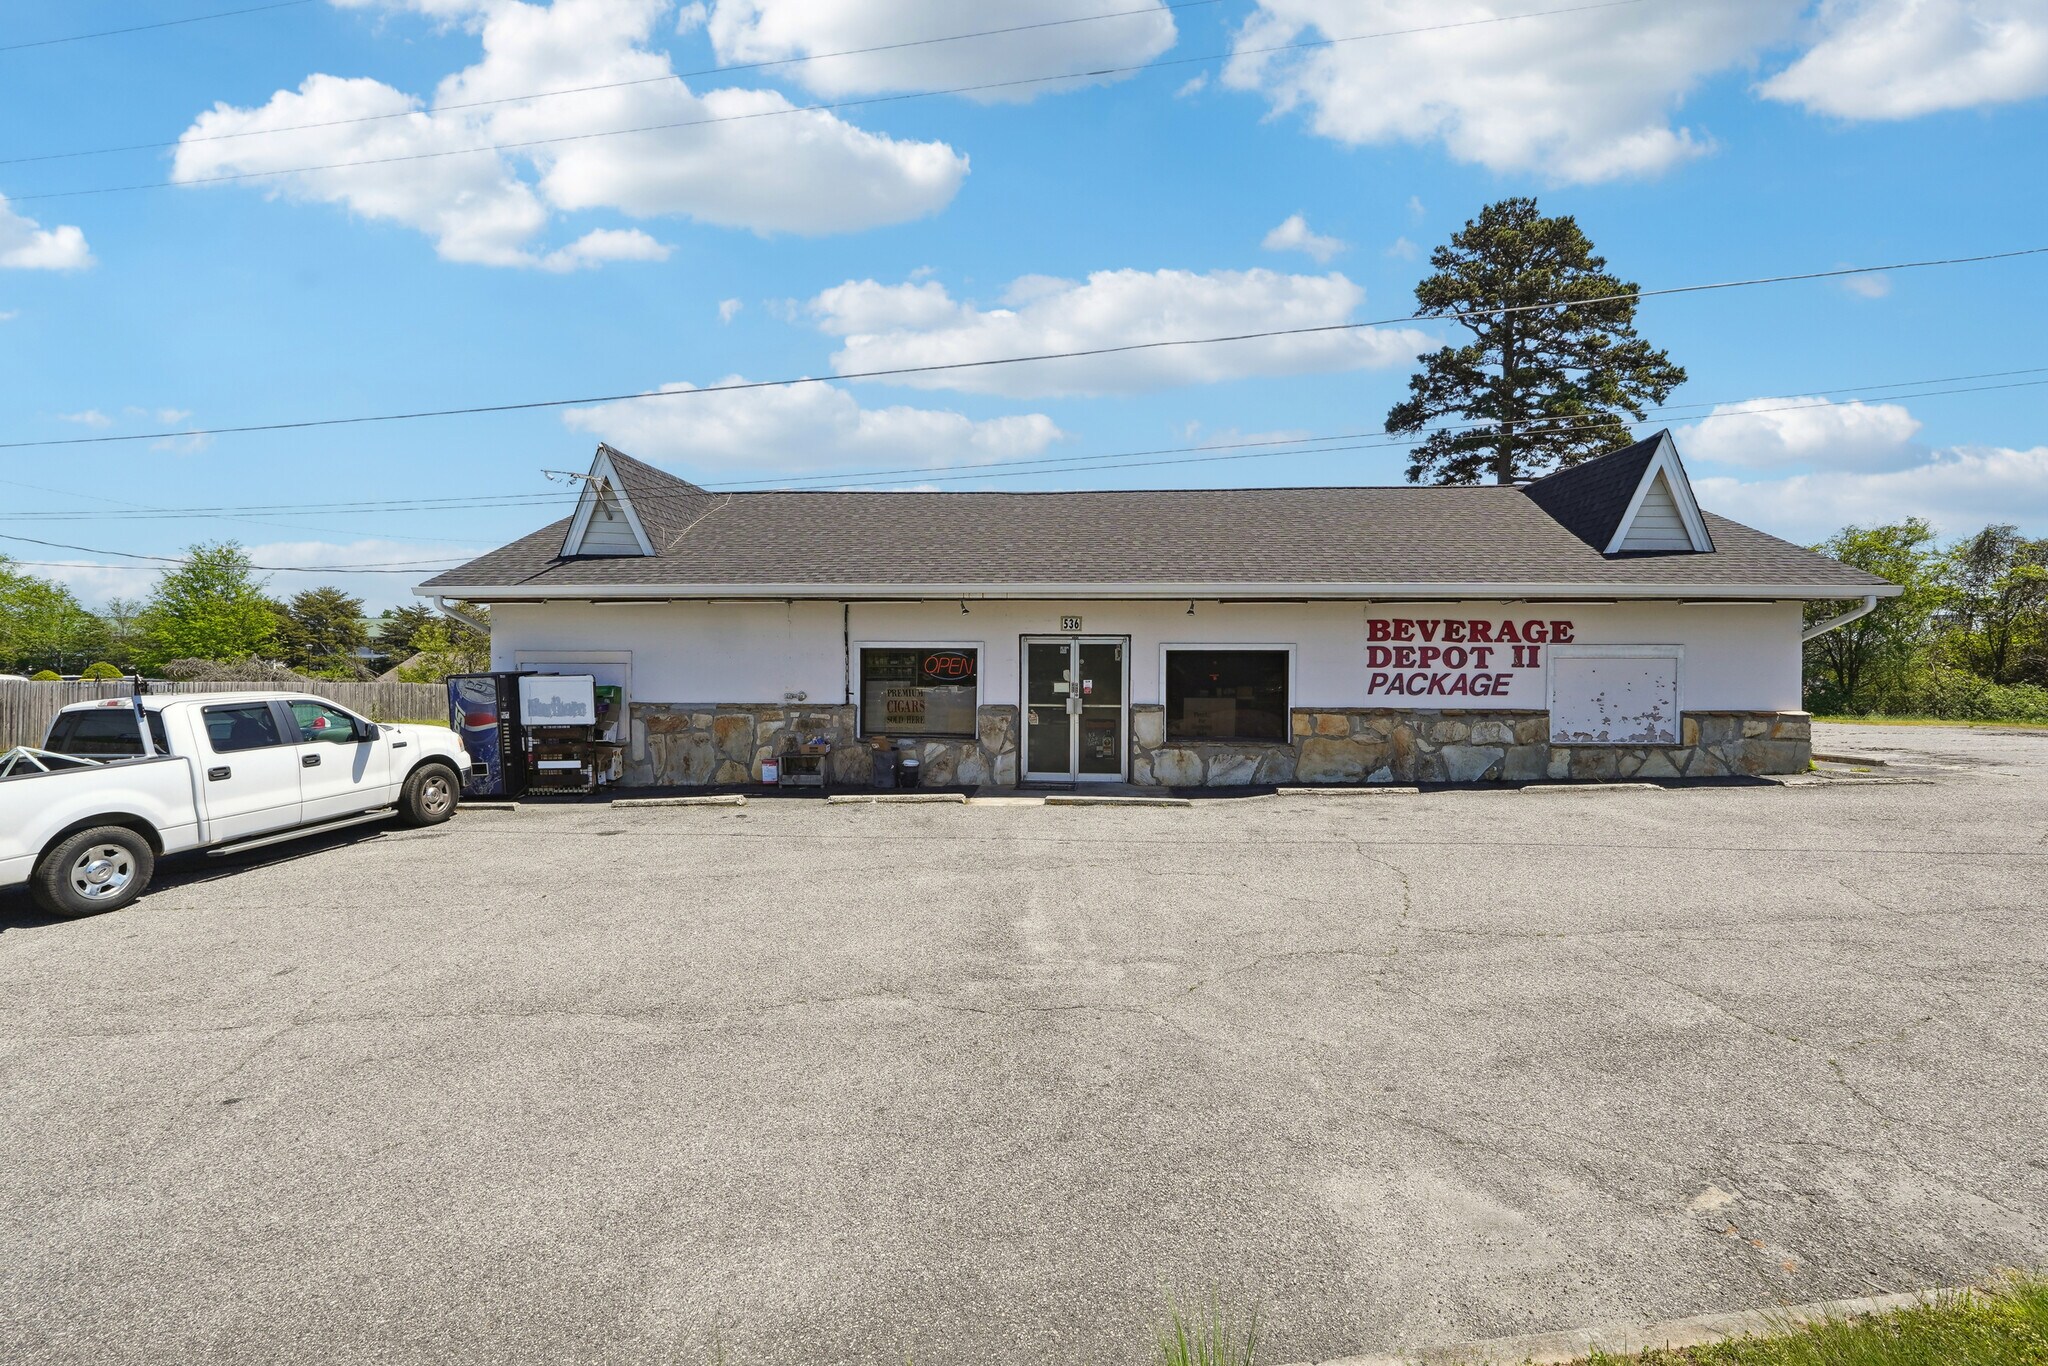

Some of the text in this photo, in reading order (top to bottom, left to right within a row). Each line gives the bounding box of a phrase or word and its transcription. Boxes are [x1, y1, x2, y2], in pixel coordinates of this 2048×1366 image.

[1063, 618, 1079, 629] 536
[1366, 618, 1575, 643] BEVERAGE
[924, 656, 974, 675] OPEN
[1366, 645, 1540, 669] DEPOT II
[887, 688, 924, 697] PREMIUM
[1367, 672, 1513, 696] PACKAGE
[887, 700, 925, 713] CIGARS
[454, 701, 466, 737] PSI
[886, 715, 925, 724] SOLD HERE
